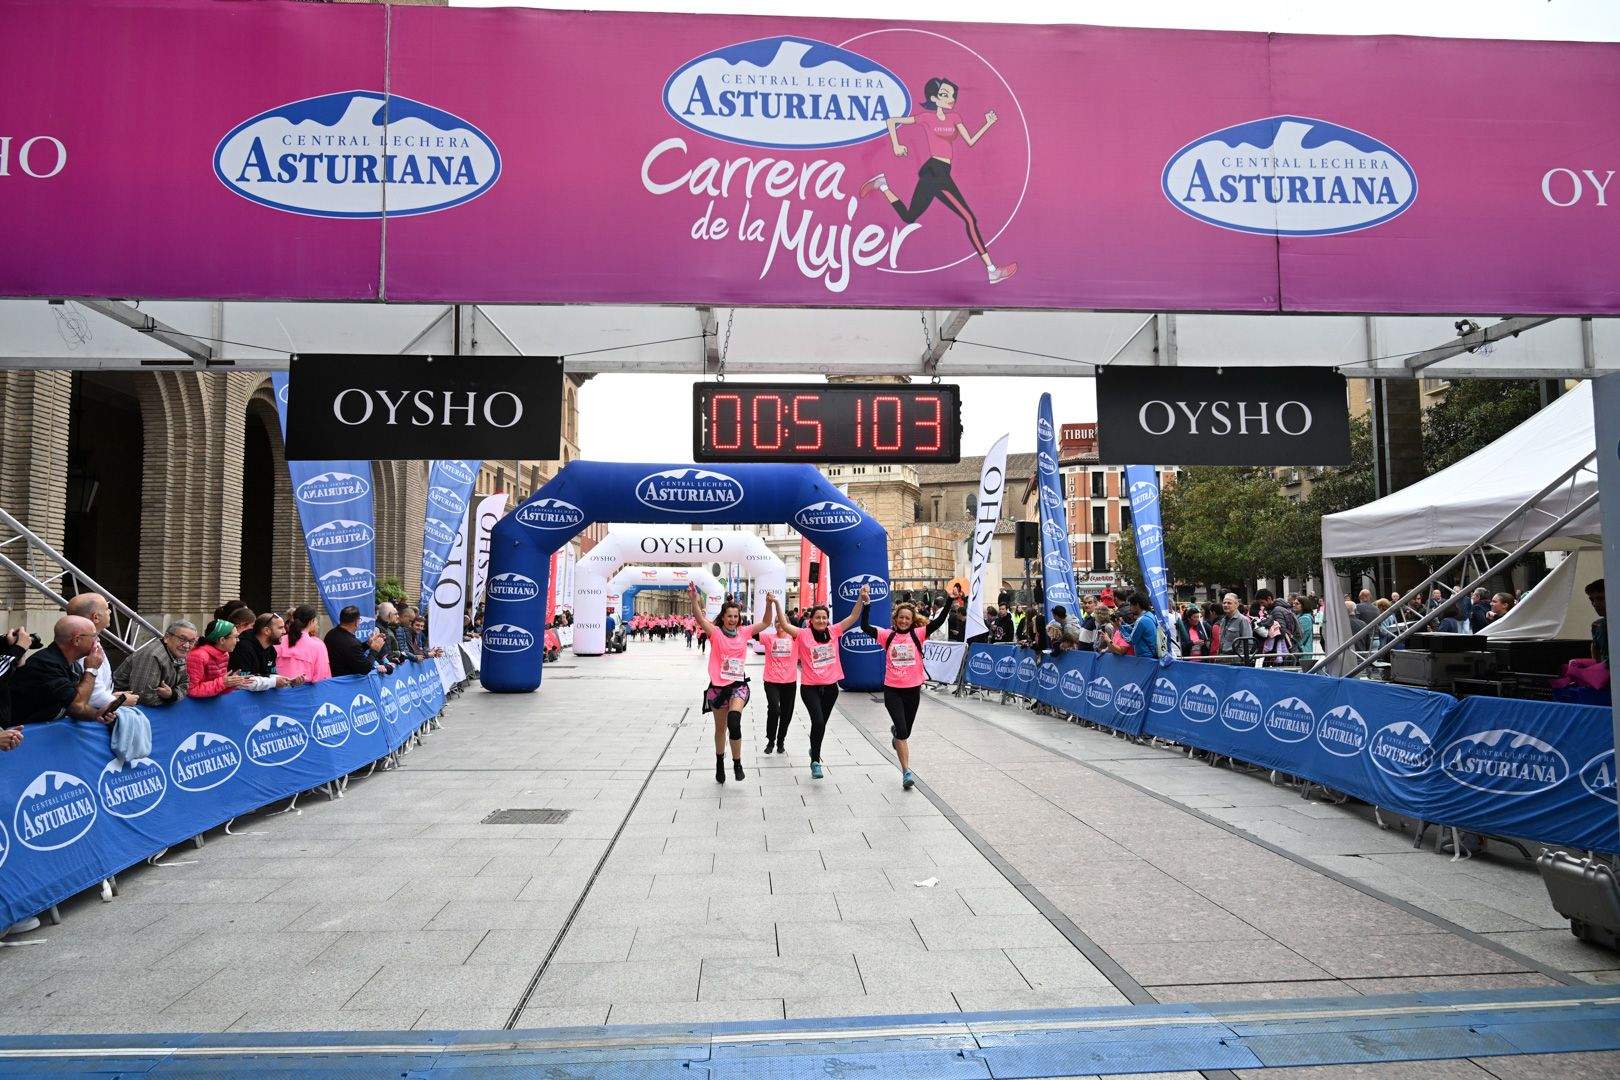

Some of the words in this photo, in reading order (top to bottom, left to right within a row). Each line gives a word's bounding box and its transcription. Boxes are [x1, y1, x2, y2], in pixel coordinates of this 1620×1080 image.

[722, 74, 799, 87] CENTRAL
[807, 76, 884, 89] LECHERA
[683, 75, 890, 122] ASTURIANA
[282, 134, 370, 148] CENTRAL
[380, 135, 470, 148] LECHERA
[236, 136, 479, 186] ASTURIANA
[641, 137, 845, 200] Carrera
[1222, 156, 1300, 168] CENTRAL
[1309, 158, 1389, 170] LECHERA
[1183, 158, 1399, 205] ASTURIANA
[1542, 168, 1616, 207] OY
[691, 200, 729, 240] de
[739, 200, 764, 242] la
[759, 195, 921, 292] Mujer
[333, 388, 524, 428] OYSHO
[1139, 400, 1313, 436] OYSHO
[644, 482, 736, 502] ASTURIANA
[520, 510, 578, 522] ASTURIANA
[800, 514, 858, 525] ASTURIANA
[640, 536, 724, 554] OYSHO
[489, 584, 535, 596] ASTURIANA
[842, 586, 887, 596] ASTIANA
[484, 634, 530, 646] ASTURIANA
[1182, 696, 1215, 714] ASTURIANA
[1222, 702, 1258, 724] ASTURIANA
[1267, 710, 1310, 734] ASTURIANA
[252, 732, 306, 759] ASTURIANA
[1468, 748, 1508, 758] CENTRAL
[177, 752, 238, 784] ASTURIANA
[1448, 748, 1557, 783] ASTURIANA
[104, 776, 164, 808] ASTURIANA
[32, 796, 59, 812] CENTRAL
[24, 797, 94, 841] ASTURIANA
